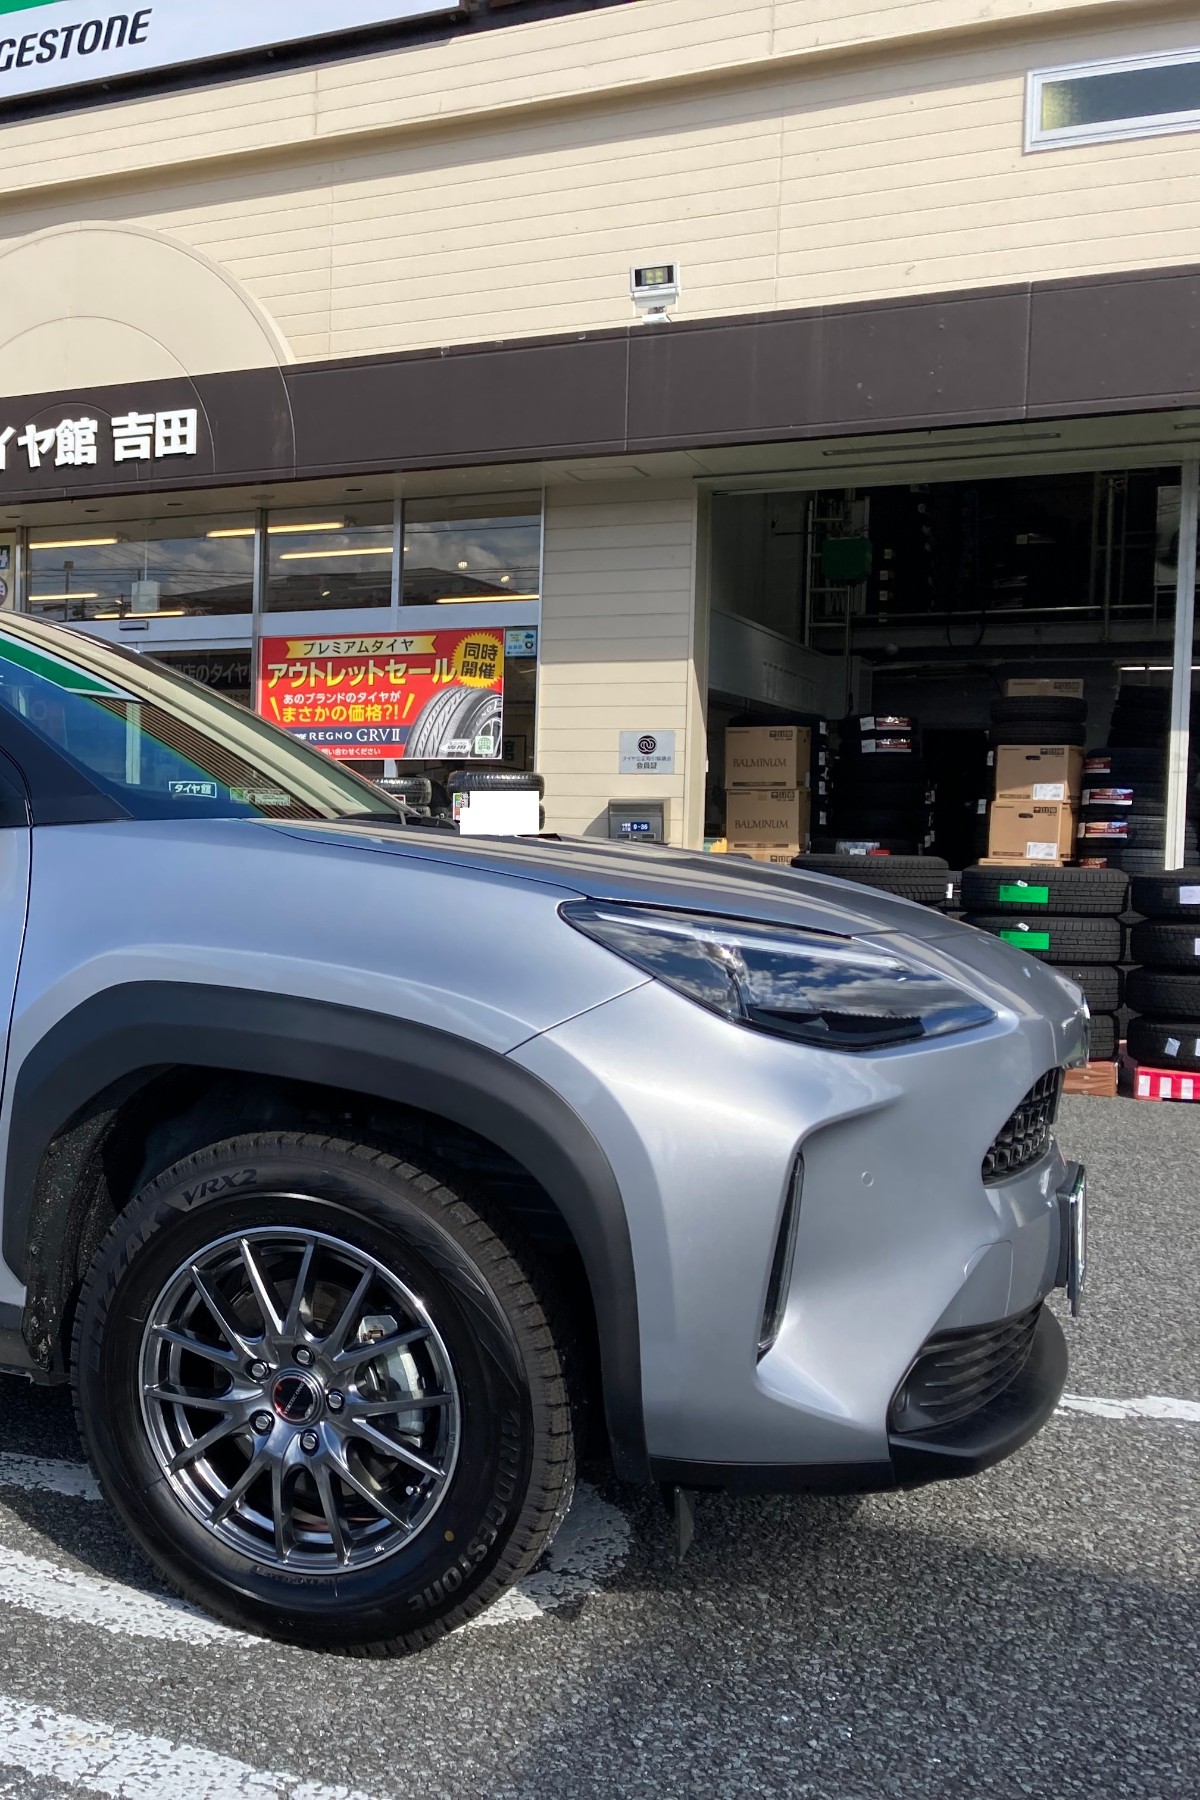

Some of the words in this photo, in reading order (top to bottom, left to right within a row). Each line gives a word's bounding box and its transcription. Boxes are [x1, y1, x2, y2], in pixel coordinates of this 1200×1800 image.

[111, 408, 198, 462] 吉田
[303, 638, 414, 656] プレミアムタイヤ
[464, 641, 498, 661] 同時
[267, 658, 457, 689] アウトレットセール
[460, 660, 495, 679] 開催
[283, 690, 401, 705] あのブランドのタイヤが
[309, 732, 353, 741] REGNO
[733, 758, 787, 768] BALMINUM
[174, 783, 212, 795] タイヤ館
[735, 819, 789, 830] BALMINUM
[181, 1168, 258, 1207] VRX2
[407, 1409, 521, 1613] BRIDGESTONE
